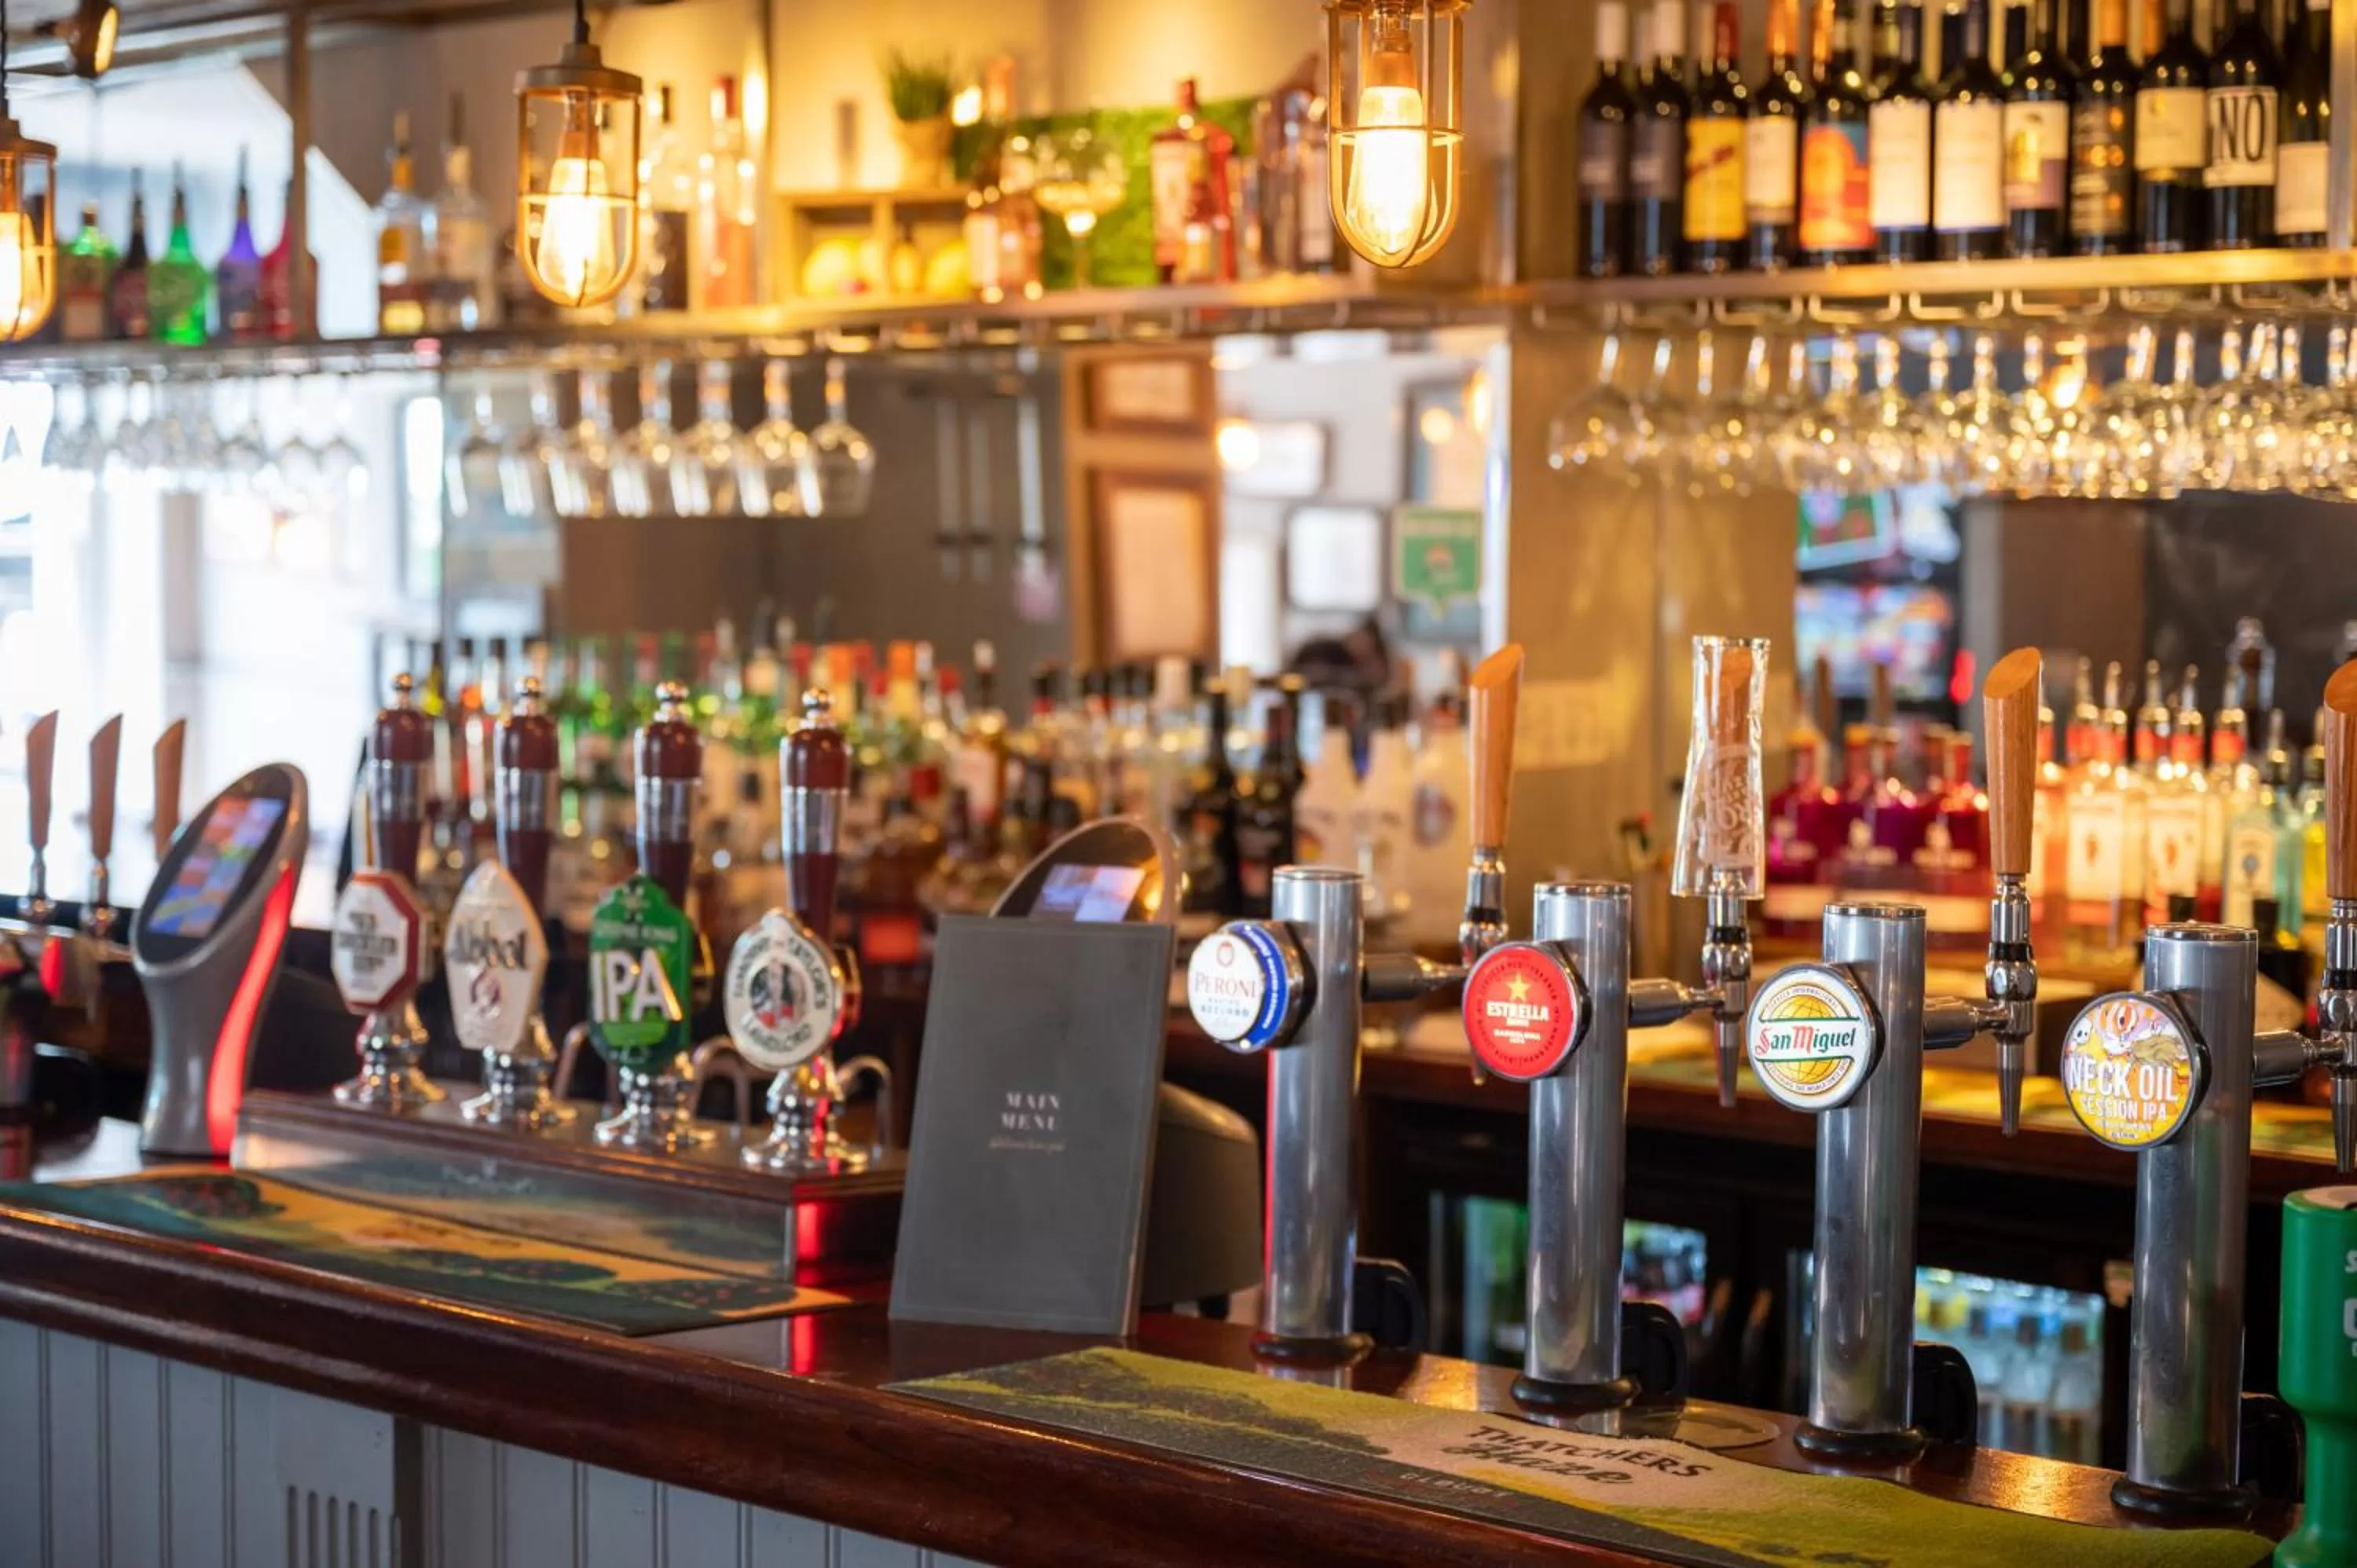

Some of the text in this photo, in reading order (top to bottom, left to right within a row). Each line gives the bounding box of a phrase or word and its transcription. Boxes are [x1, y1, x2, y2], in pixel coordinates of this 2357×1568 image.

[591, 946, 684, 1024] IPA
[1194, 970, 1256, 999] PERONI
[1486, 1000, 1550, 1022] ESTRELLA
[1754, 1025, 1857, 1056] San Miguel
[2069, 1055, 2179, 1102] NECK OIL
[1005, 1090, 1061, 1110] MAIN
[2080, 1095, 2168, 1122] SESSION IPA
[1000, 1112, 1058, 1132] MENU
[1468, 1424, 1714, 1478] THATCHERS
